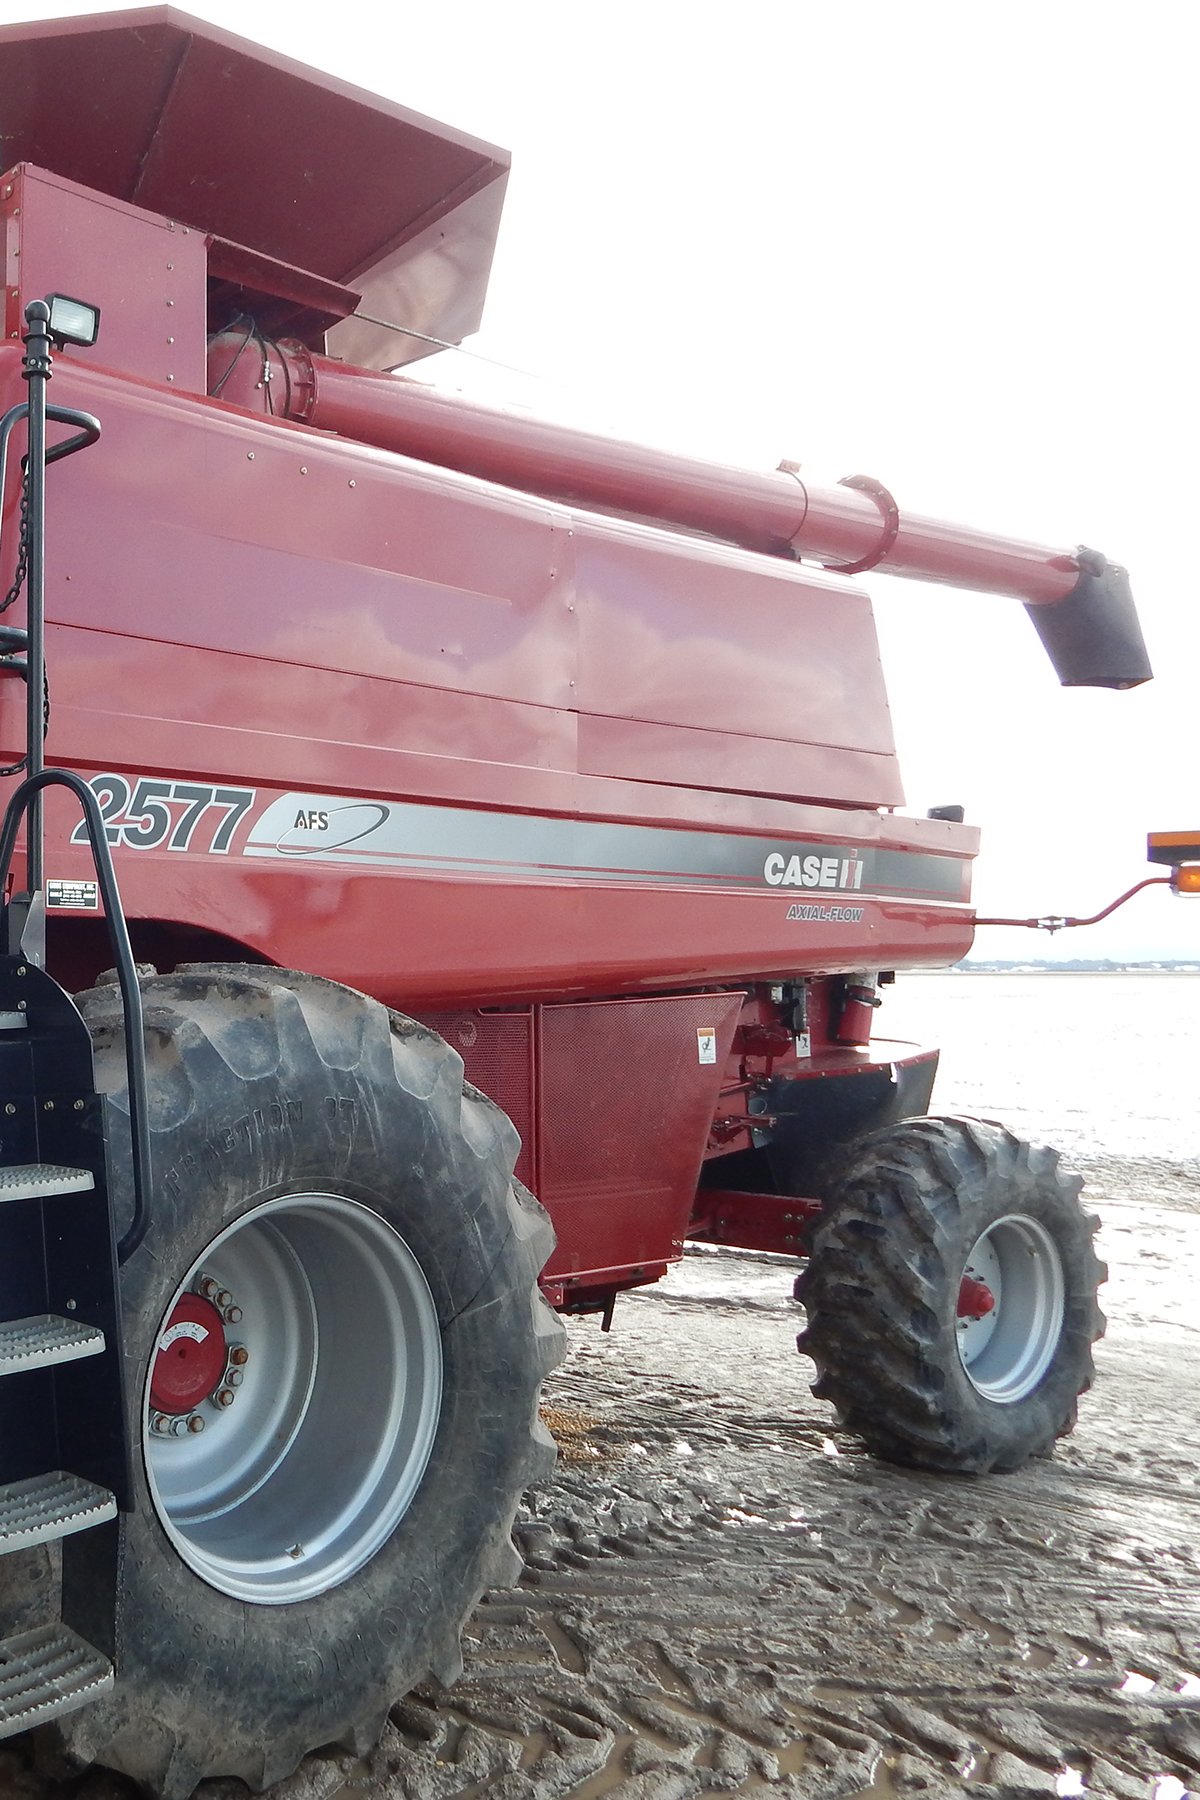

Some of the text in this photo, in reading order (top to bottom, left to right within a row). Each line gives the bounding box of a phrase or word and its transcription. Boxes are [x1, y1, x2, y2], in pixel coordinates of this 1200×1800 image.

[70, 773, 257, 855] 2577
[293, 809, 330, 832] AFS
[763, 852, 839, 888] CASE
[786, 904, 864, 922] AXIAL-FLOW
